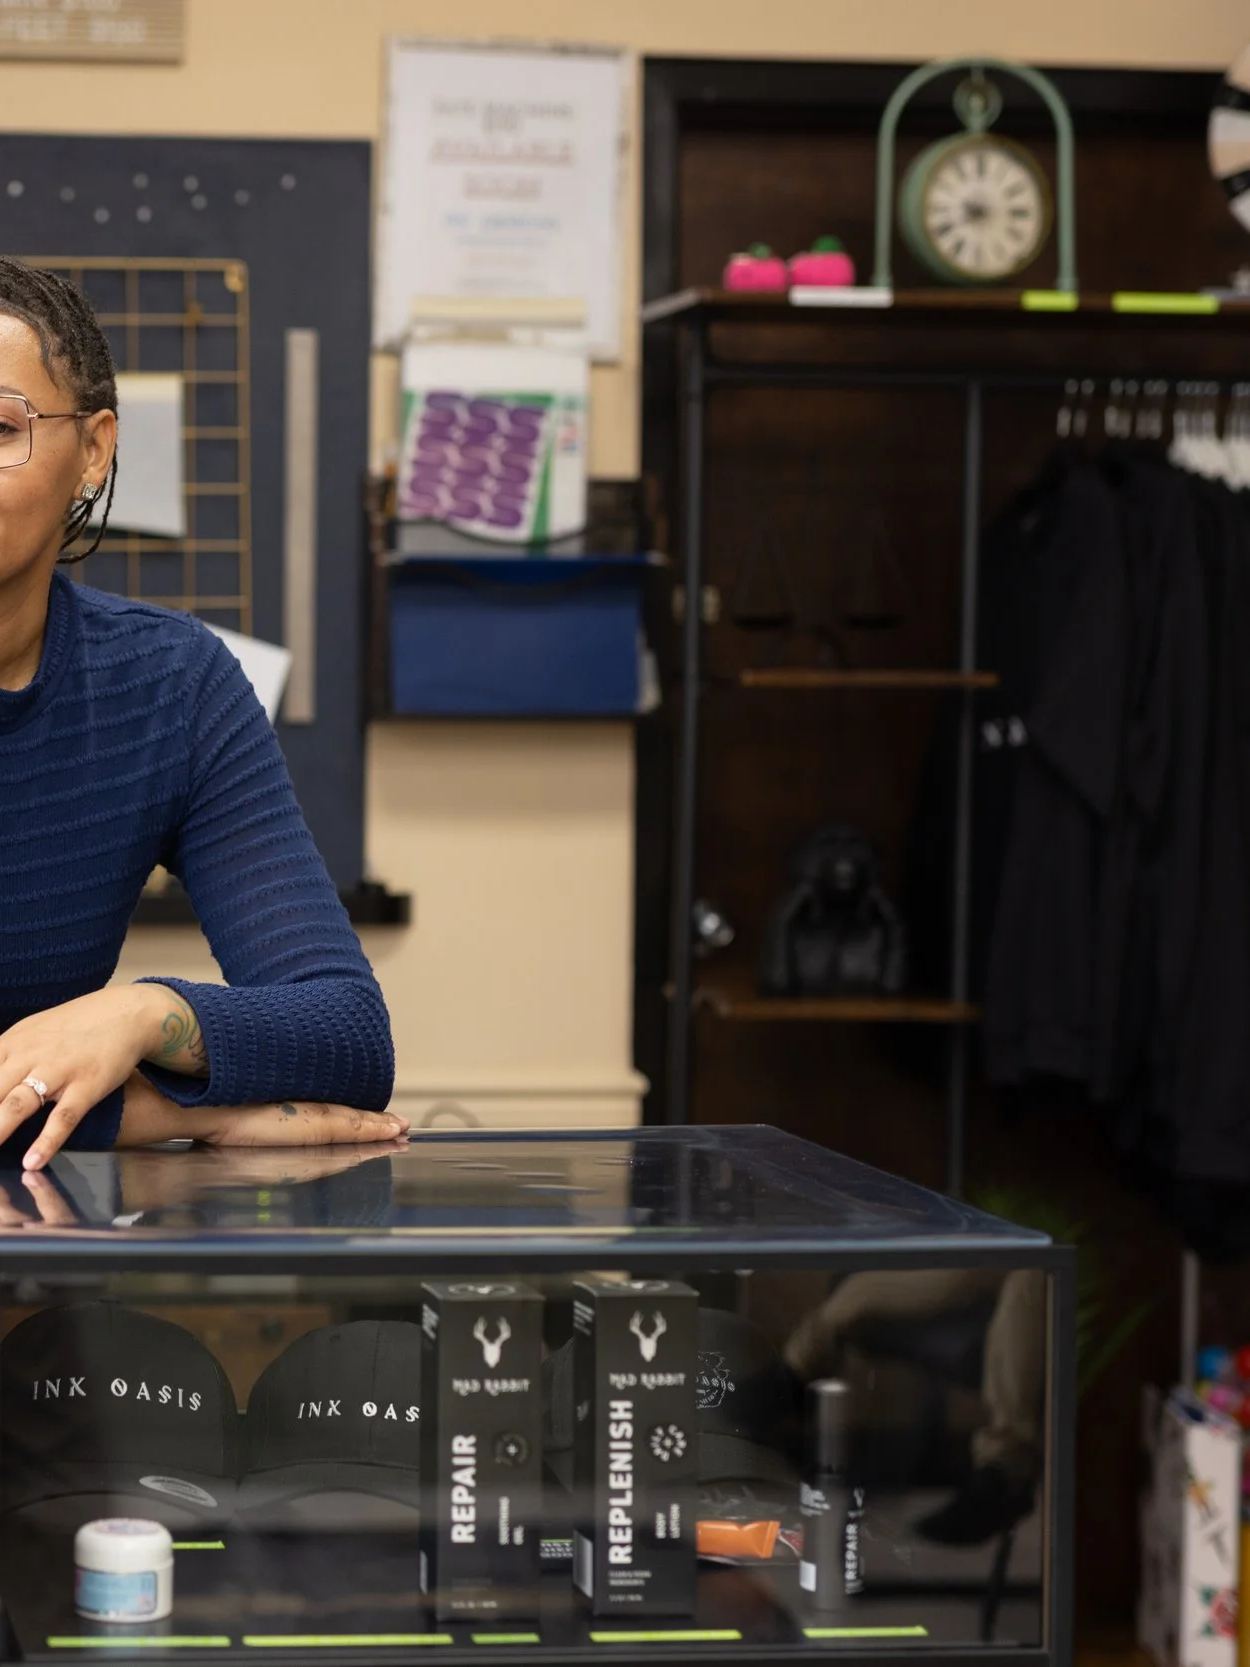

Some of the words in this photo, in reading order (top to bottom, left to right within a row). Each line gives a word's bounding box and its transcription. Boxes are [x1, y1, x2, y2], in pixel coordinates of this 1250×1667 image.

[33, 1376, 87, 1401] INK
[110, 1377, 202, 1411] OASIS
[452, 1378, 481, 1397] MAD
[484, 1378, 531, 1397] RABBIT
[608, 1372, 637, 1391] MAD
[640, 1372, 686, 1391] RABBIT
[297, 1399, 341, 1420] INK
[362, 1401, 420, 1423] OAS
[451, 1434, 477, 1543] REPAIR
[608, 1400, 633, 1564] REPLENISH
[845, 1523, 858, 1581] REPAIR
